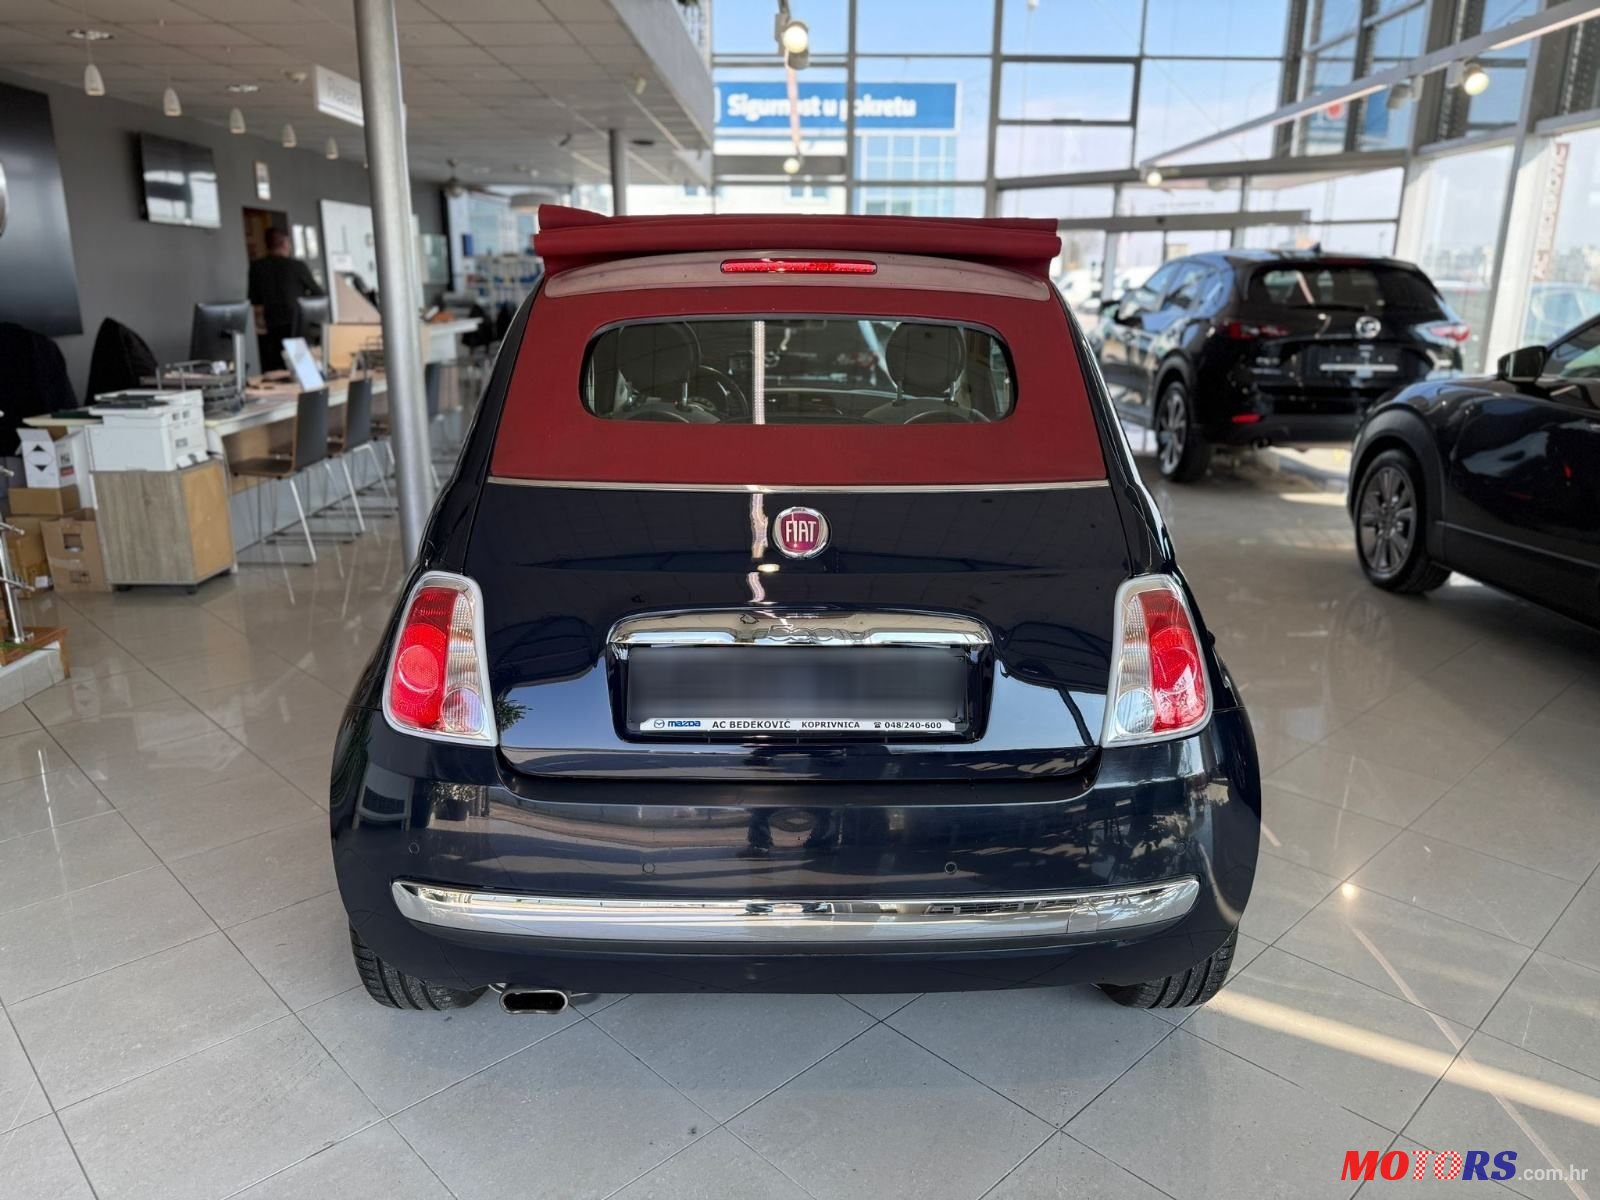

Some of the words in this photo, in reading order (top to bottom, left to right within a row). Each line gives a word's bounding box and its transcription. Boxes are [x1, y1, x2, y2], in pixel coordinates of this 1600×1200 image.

[822, 98, 838, 117] u
[785, 520, 817, 543] FIAT
[667, 720, 701, 728] mazda
[712, 721, 726, 729] AC
[801, 721, 861, 729] KOPRIVNICA
[884, 721, 943, 730] 048/240-600
